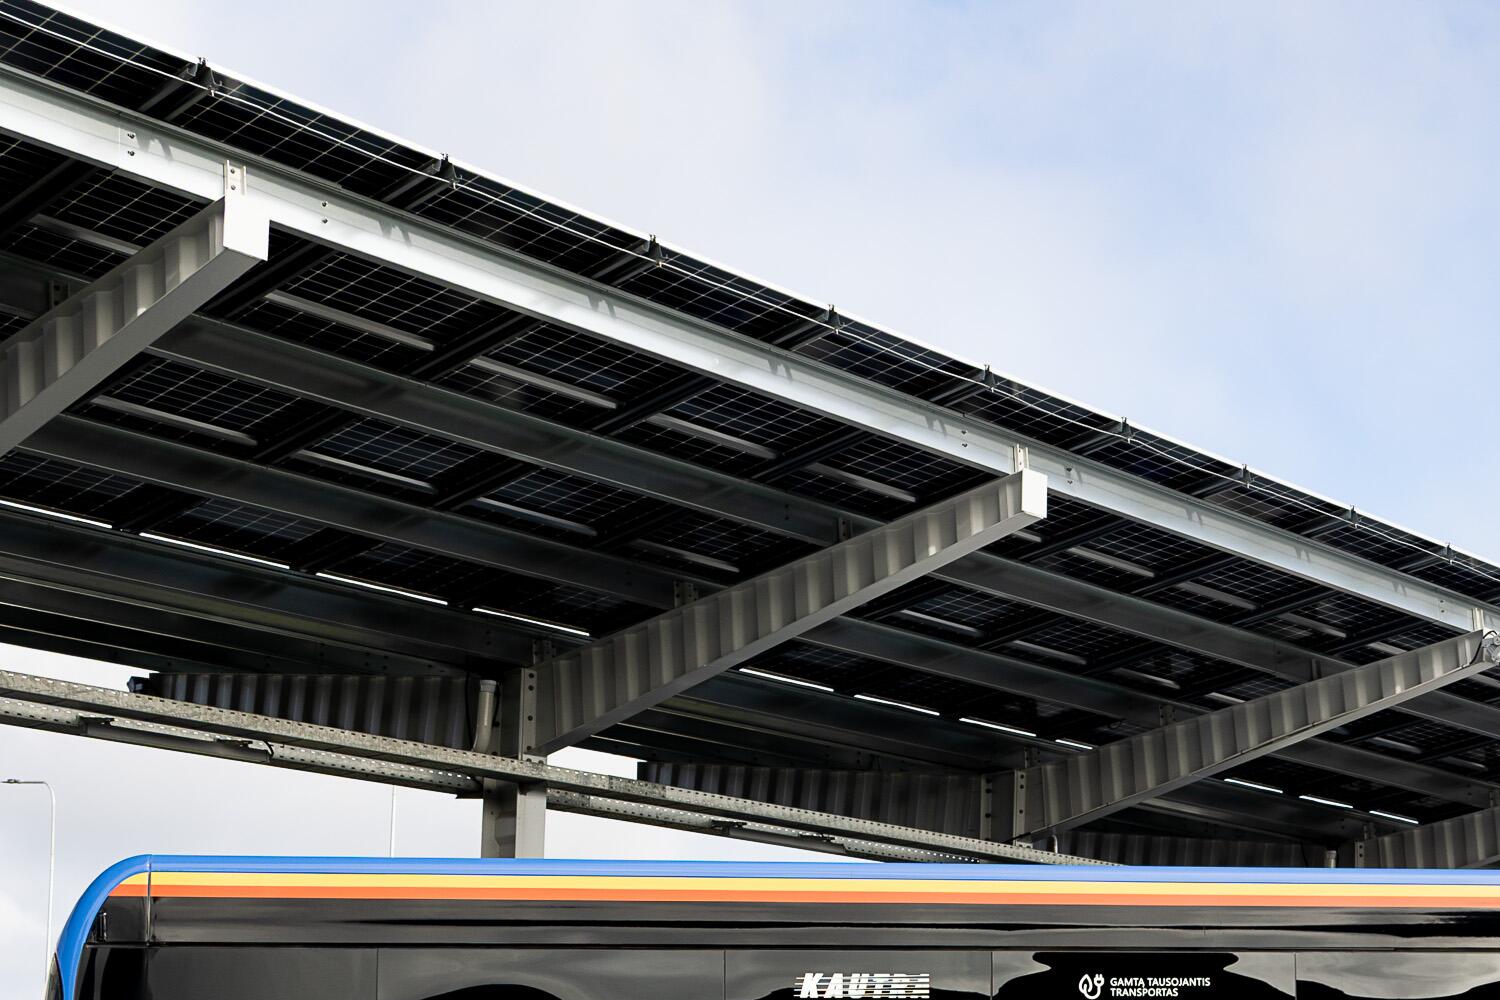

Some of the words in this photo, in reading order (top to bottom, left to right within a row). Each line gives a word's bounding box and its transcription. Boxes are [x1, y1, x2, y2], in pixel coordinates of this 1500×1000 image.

[1110, 977, 1146, 988] GAMTĄ
[1147, 977, 1211, 987] TAUSOJANTIS
[1110, 987, 1179, 997] TRANSPORTAS
